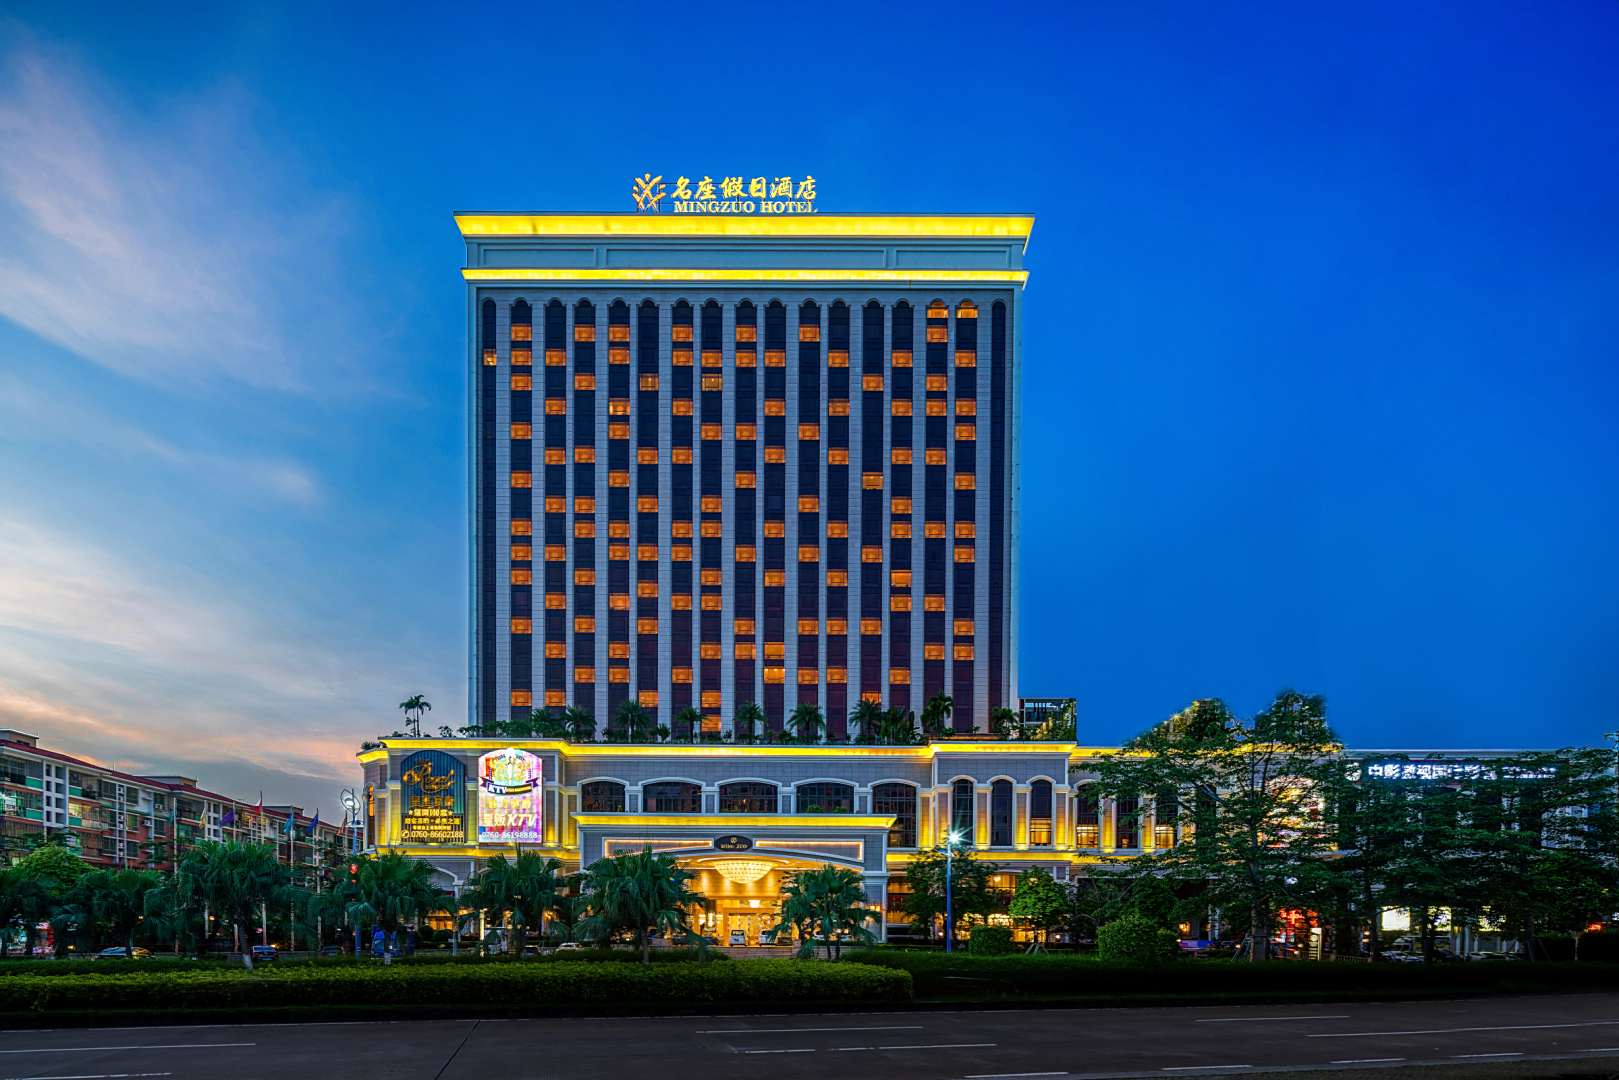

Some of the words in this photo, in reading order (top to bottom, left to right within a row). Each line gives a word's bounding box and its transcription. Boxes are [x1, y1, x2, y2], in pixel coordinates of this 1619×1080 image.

[672, 175, 817, 200] 名座假日酒店
[673, 201, 755, 213] MINGZUO
[760, 201, 818, 213] HOTEL
[411, 830, 464, 838] 0760-86602188
